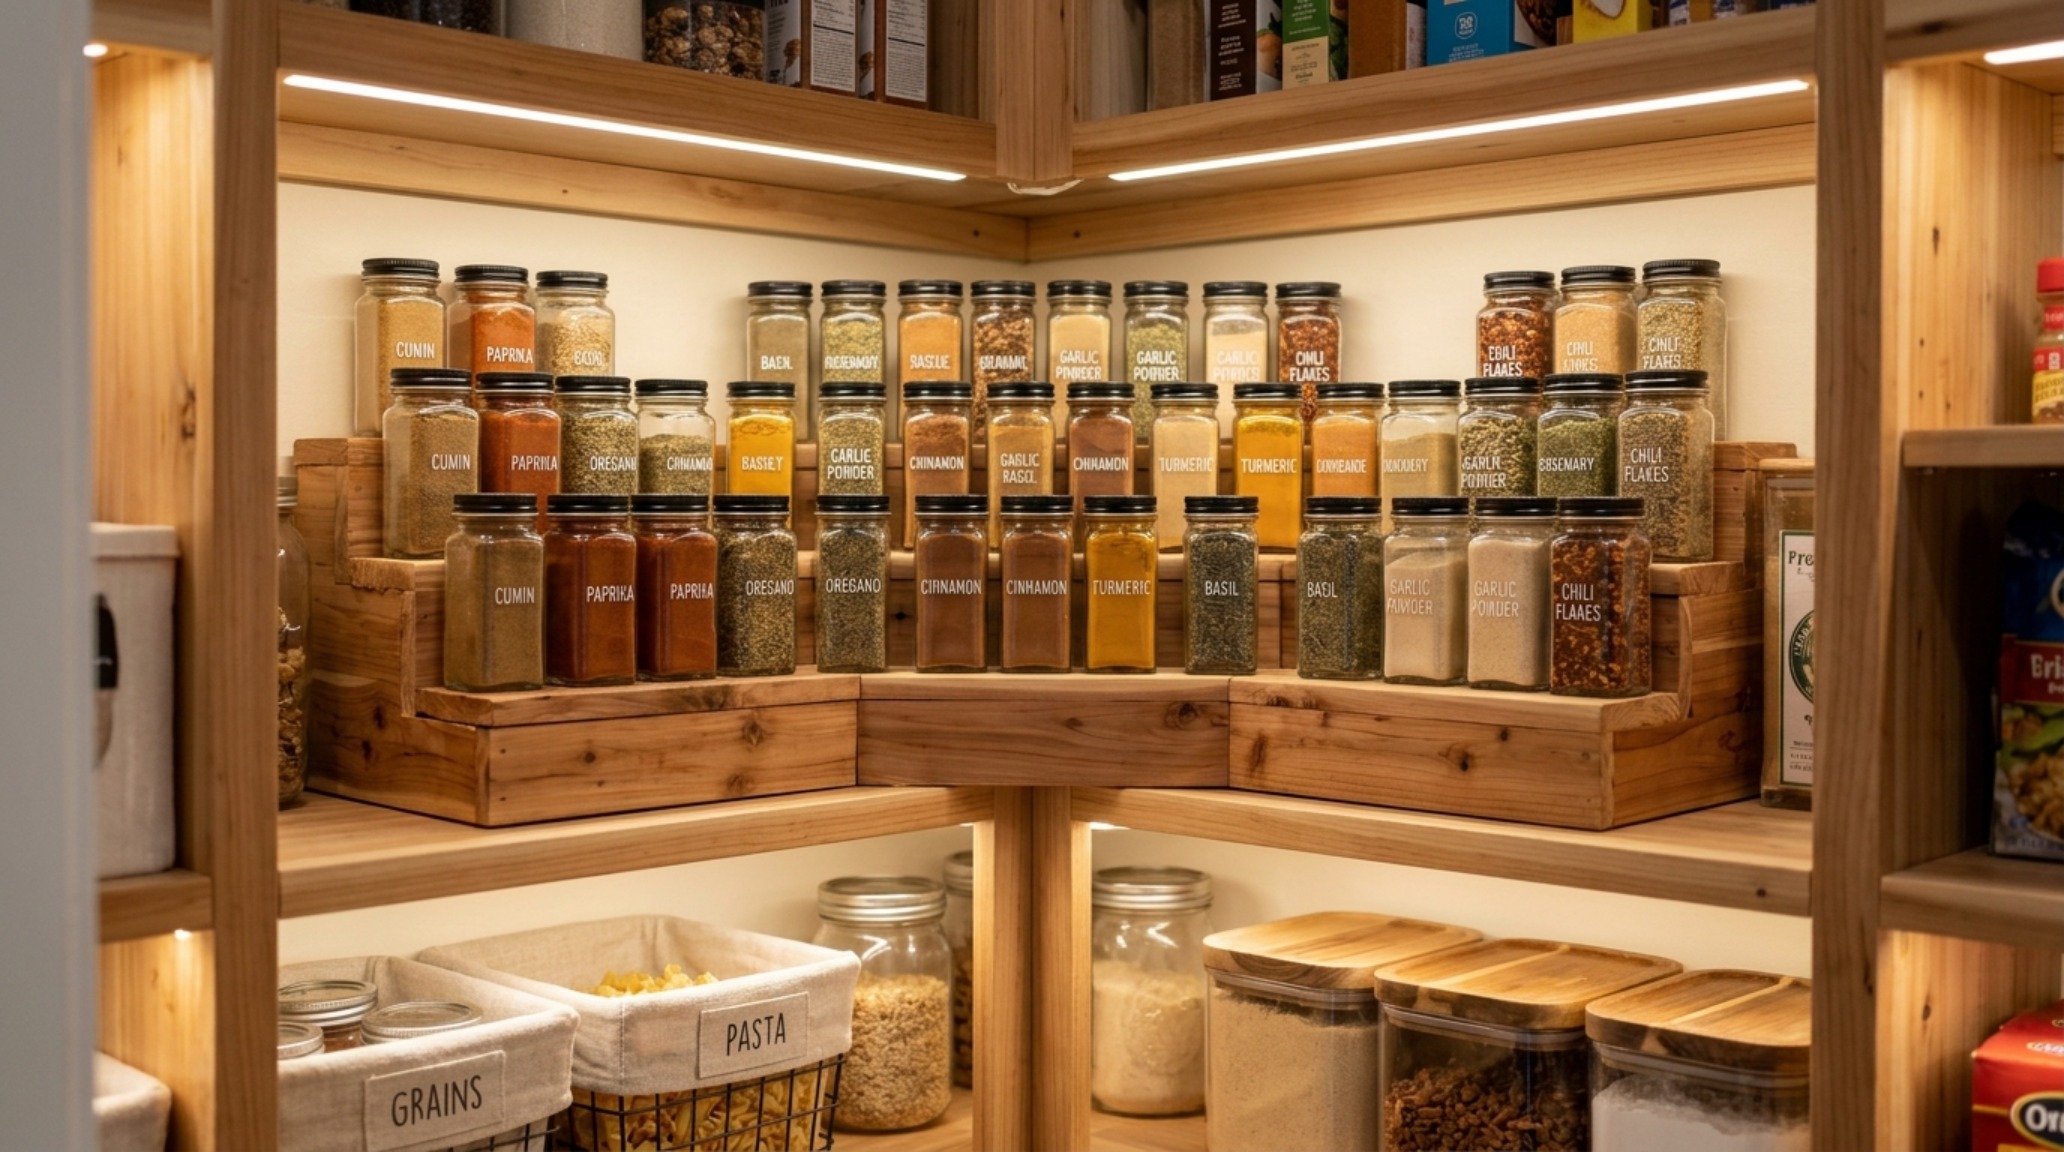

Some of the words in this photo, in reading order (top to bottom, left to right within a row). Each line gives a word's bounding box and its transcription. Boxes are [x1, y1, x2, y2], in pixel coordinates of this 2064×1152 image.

[396, 341, 435, 359] CUMIN
[1136, 350, 1177, 365] GARLIC
[431, 453, 471, 471] CUMIN
[1159, 457, 1213, 472] TURMERIC
[1240, 458, 1297, 473] TURMERIC
[494, 585, 536, 605] CUMIN
[586, 584, 635, 603] PAPRIKA
[1093, 579, 1151, 596] TURMERIC
[1205, 580, 1239, 597] BASIL
[1561, 582, 1594, 602] CHILI
[2031, 653, 2064, 679] Bri
[726, 1012, 786, 1056] PASTA
[391, 1074, 482, 1127] GRAINS
